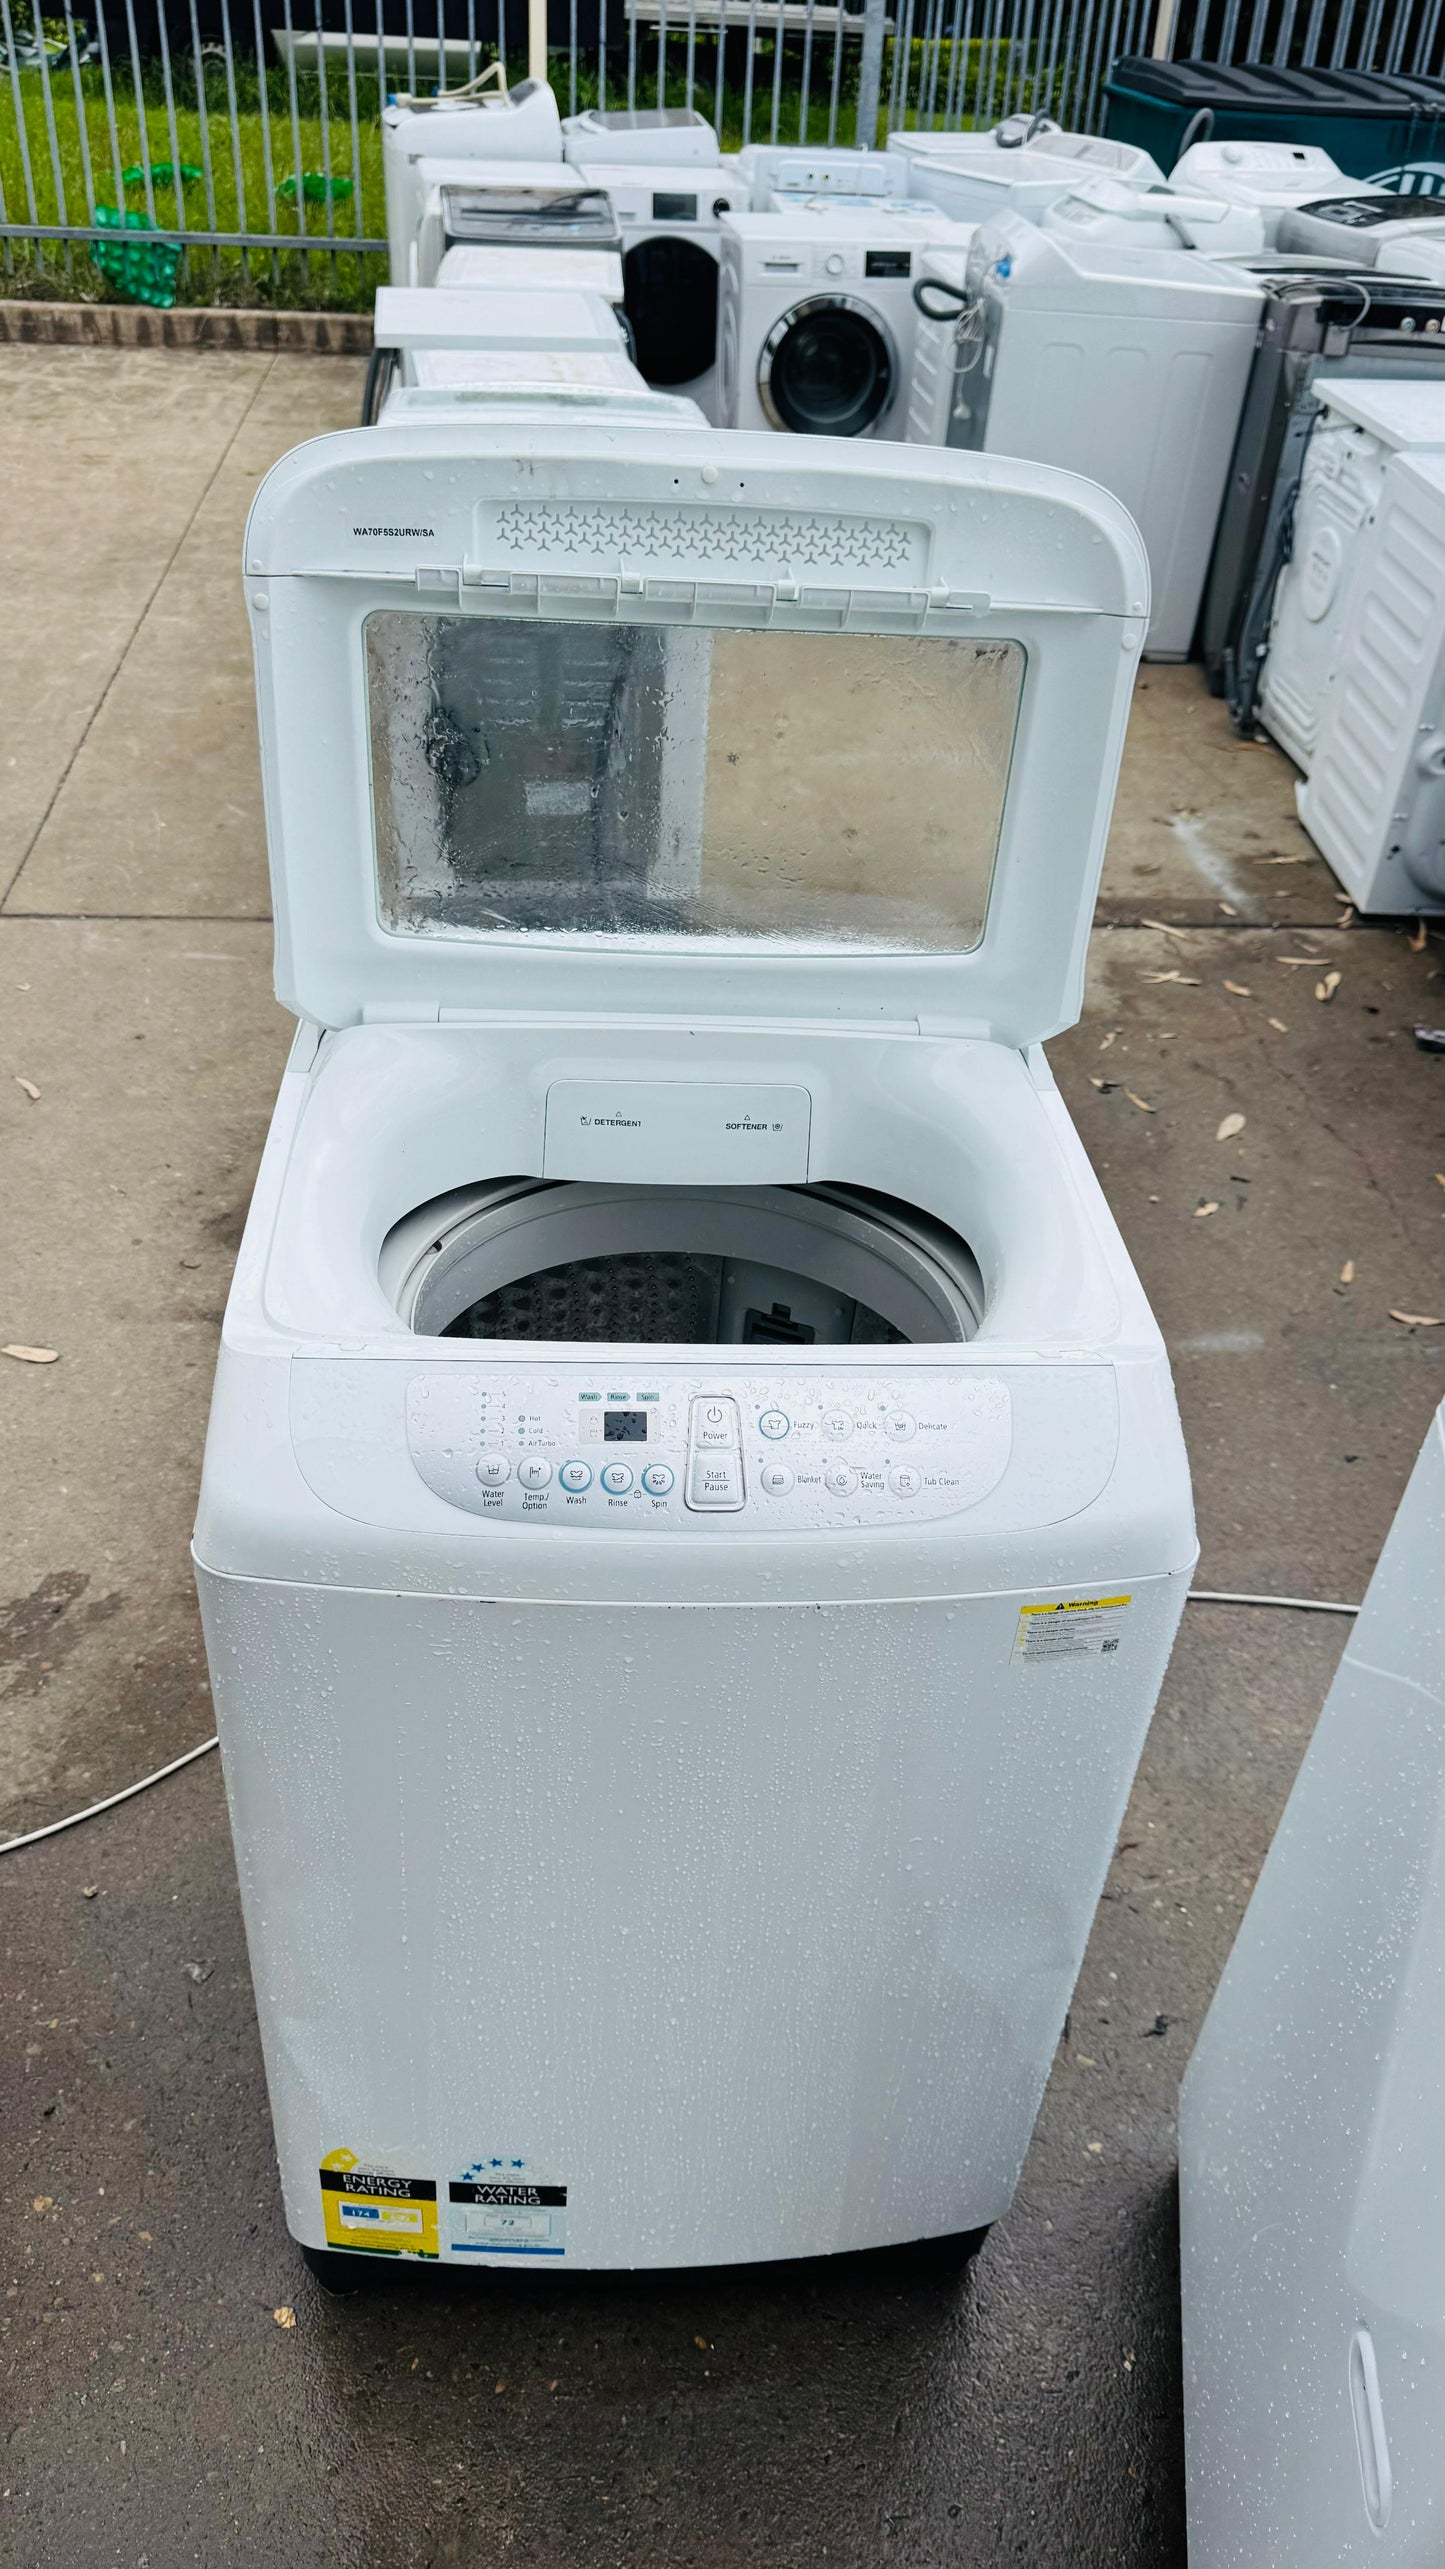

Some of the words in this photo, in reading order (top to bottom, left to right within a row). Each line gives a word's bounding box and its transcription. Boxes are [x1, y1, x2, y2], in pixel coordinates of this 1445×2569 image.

[353, 528, 434, 537] WA70F5S2URW/SA
[594, 1118, 641, 1127] DETERGENT
[793, 1421, 814, 1430] Fuzzy
[856, 1421, 878, 1430] Quick
[918, 1422, 948, 1430] Delicate
[703, 1431, 728, 1440] Power
[706, 1470, 727, 1479] Start
[860, 1472, 882, 1480] Water
[797, 1475, 822, 1484] Blanket
[924, 1478, 937, 1486] Tub
[939, 1478, 960, 1486] Clean
[704, 1482, 729, 1491] Pause
[861, 1481, 885, 1490] Saving
[482, 1490, 504, 1498] Water
[483, 1499, 503, 1507] Level
[566, 1496, 587, 1504] Wash
[608, 1498, 628, 1507] Rinse
[651, 1500, 668, 1509] Spin
[522, 1501, 548, 1511] Option
[1068, 1600, 1099, 1608] Warning
[342, 2174, 412, 2188] ENERGY
[345, 2183, 411, 2197] RATING
[477, 2185, 538, 2196] WATER
[475, 2194, 541, 2205] RATING
